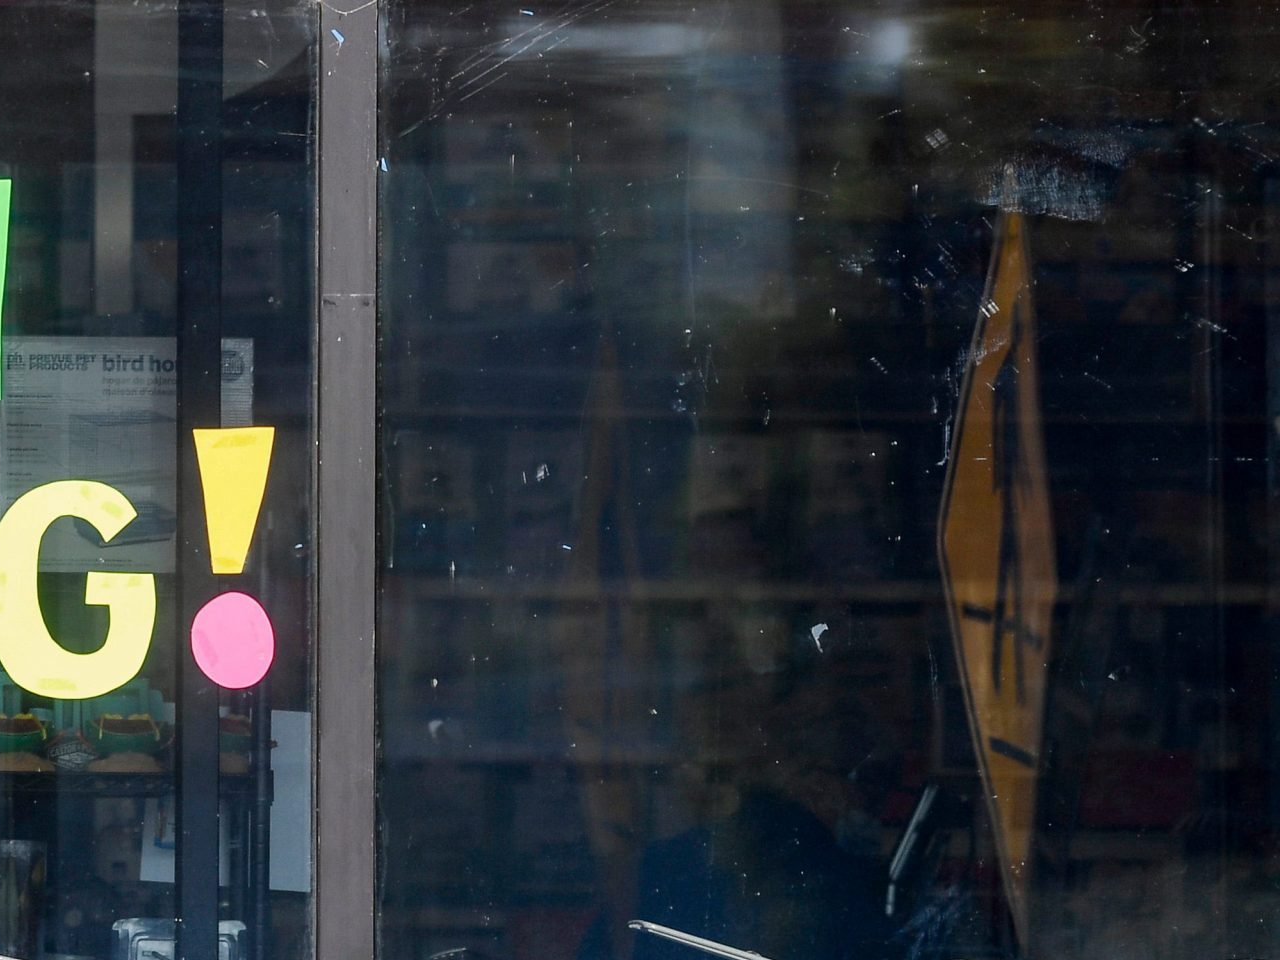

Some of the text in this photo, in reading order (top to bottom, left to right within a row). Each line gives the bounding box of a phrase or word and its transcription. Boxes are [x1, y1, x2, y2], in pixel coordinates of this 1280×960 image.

[29, 353, 97, 363] PREVUE PET
[102, 354, 178, 372] bird ho
[29, 361, 89, 371] PRODUCTS
